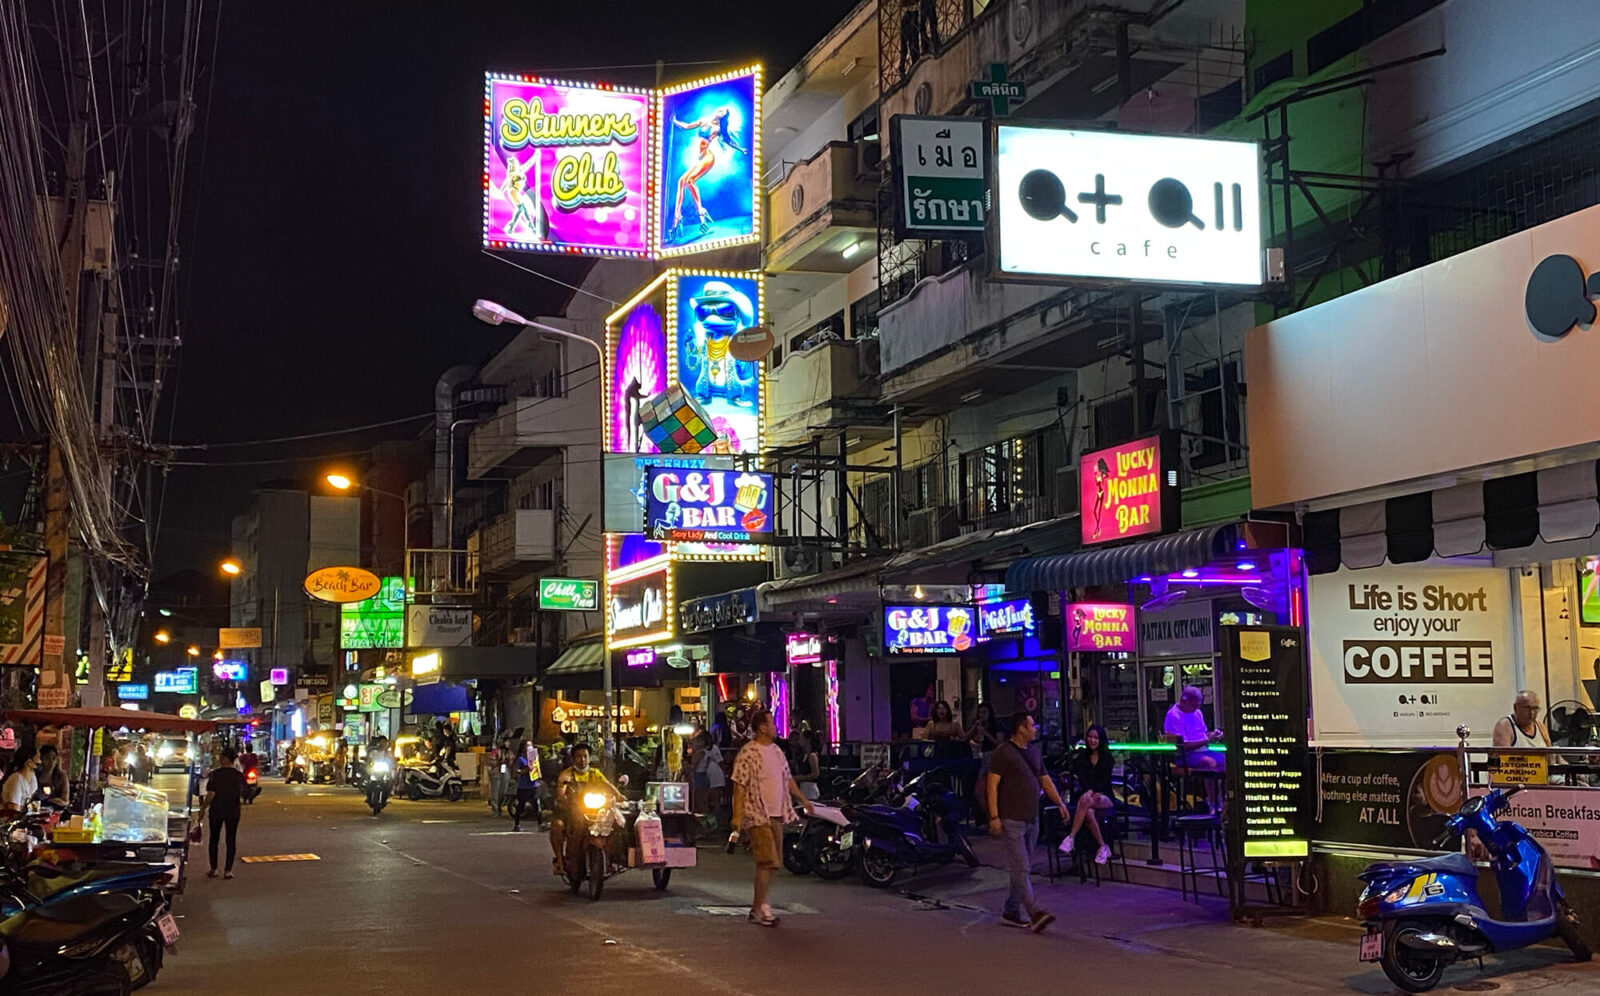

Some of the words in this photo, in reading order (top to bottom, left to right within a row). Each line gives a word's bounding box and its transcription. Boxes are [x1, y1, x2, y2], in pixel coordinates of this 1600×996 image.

[982, 83, 1019, 96] คลินิก
[501, 97, 638, 147] Stunners
[552, 152, 626, 206] Club
[913, 187, 984, 222] รักษา
[1090, 240, 1178, 259] cafe
[652, 472, 725, 506] G&J
[682, 506, 736, 528] BAR
[672, 530, 688, 540] Sexy
[688, 530, 704, 540] Lady
[704, 531, 718, 539] And
[718, 531, 733, 540] Cool
[313, 577, 347, 593] Beach
[349, 577, 373, 593] Bar
[544, 582, 577, 598] Chill
[571, 593, 594, 607] Inn
[1348, 584, 1392, 611] Life
[1397, 585, 1417, 611] is
[1422, 584, 1488, 612] Short
[888, 607, 939, 631] G&J
[1373, 614, 1420, 636] enjoy
[1422, 616, 1461, 636] your
[908, 630, 948, 646] BAR
[1344, 645, 1494, 679] COFFEE
[1320, 772, 1340, 784] After
[1341, 775, 1346, 784] a
[1347, 775, 1362, 787] cup
[1363, 773, 1371, 785] of
[1320, 790, 1350, 804] Nothing
[1352, 791, 1368, 802] else
[1369, 792, 1400, 803] matters
[1359, 807, 1375, 824] AT
[1376, 807, 1400, 825] ALL
[1555, 830, 1578, 840] Coffee
